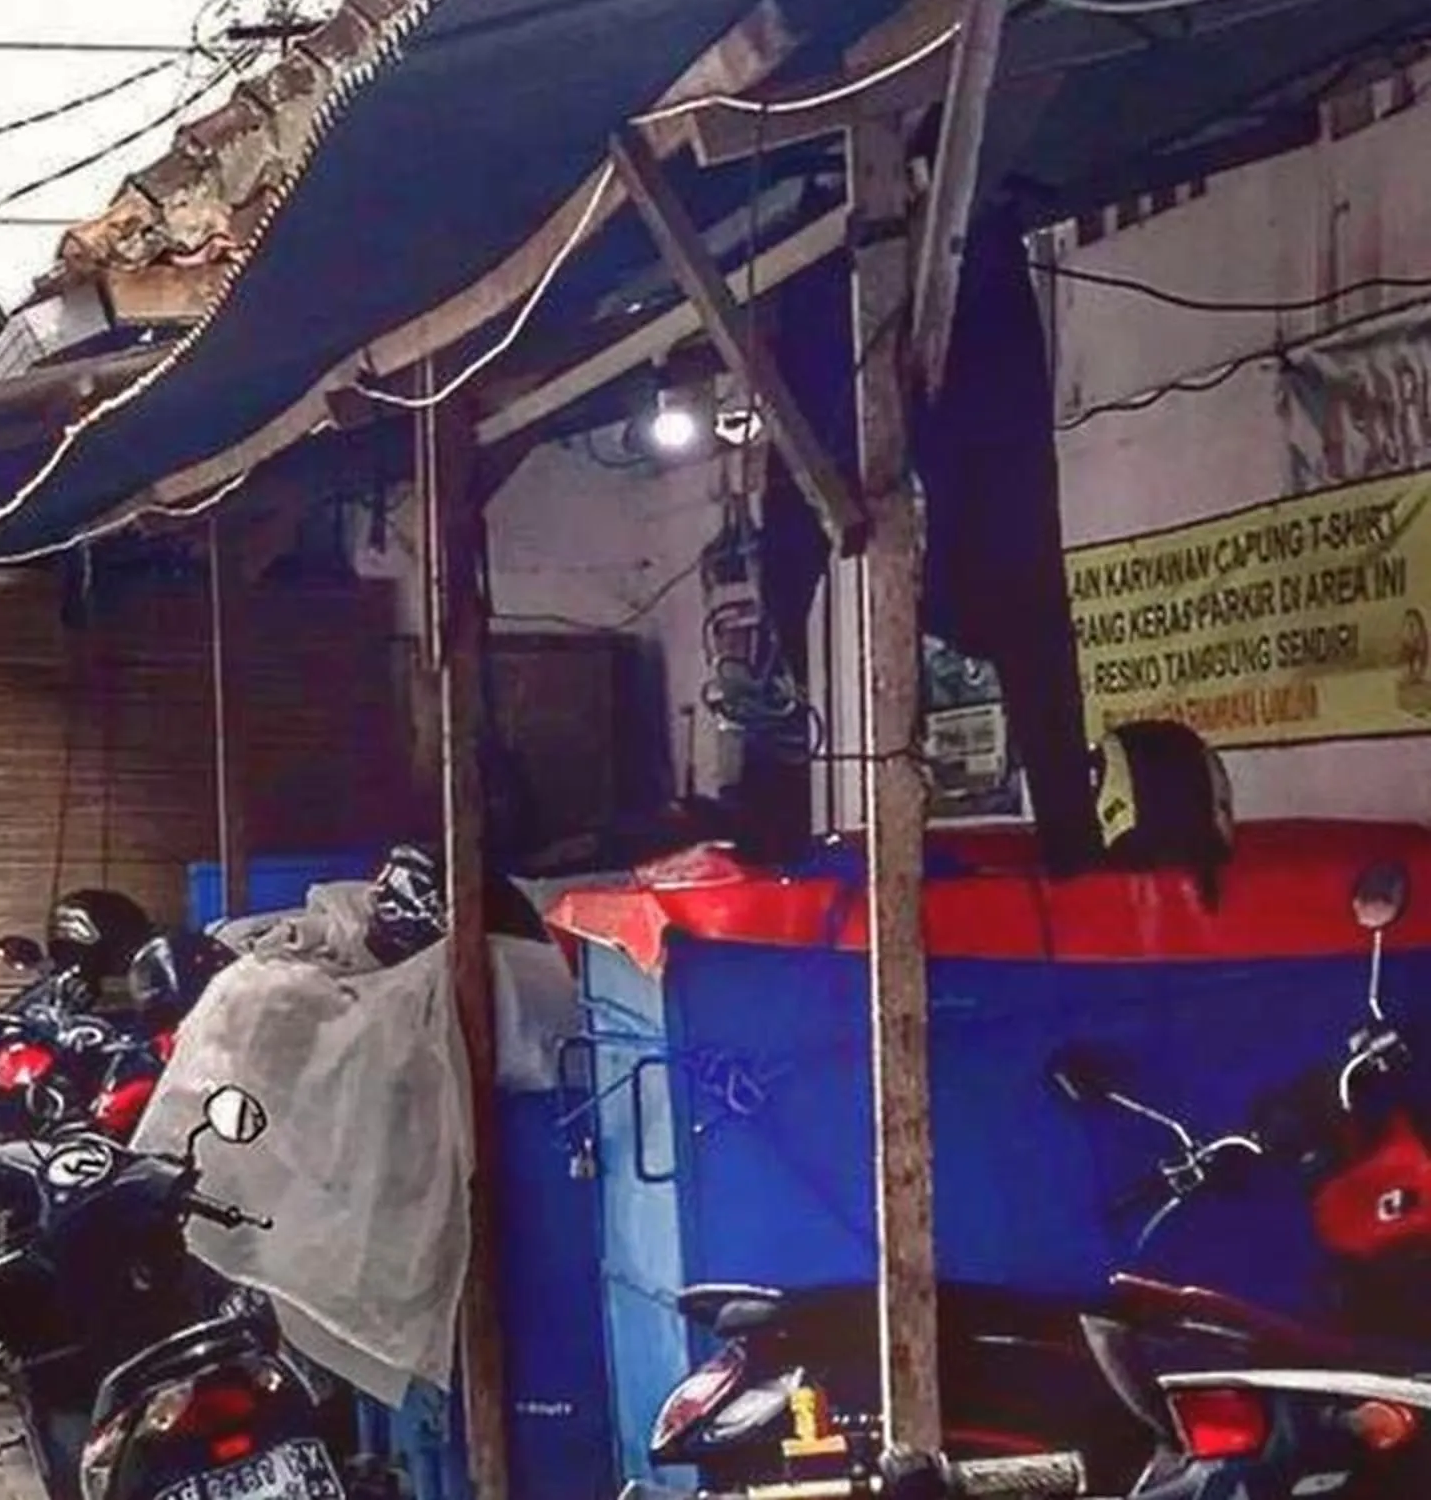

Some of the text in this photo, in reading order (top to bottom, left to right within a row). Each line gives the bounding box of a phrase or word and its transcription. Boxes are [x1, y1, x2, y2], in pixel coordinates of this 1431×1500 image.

[1105, 548, 1211, 597] KARYAWAN
[1129, 598, 1193, 643] KERAS
[1196, 579, 1276, 631] PARKIR
[1305, 564, 1369, 610] AREA
[1374, 554, 1407, 599] INI
[1094, 622, 1359, 695] RESIKO TANGGUNG SENDIRI
